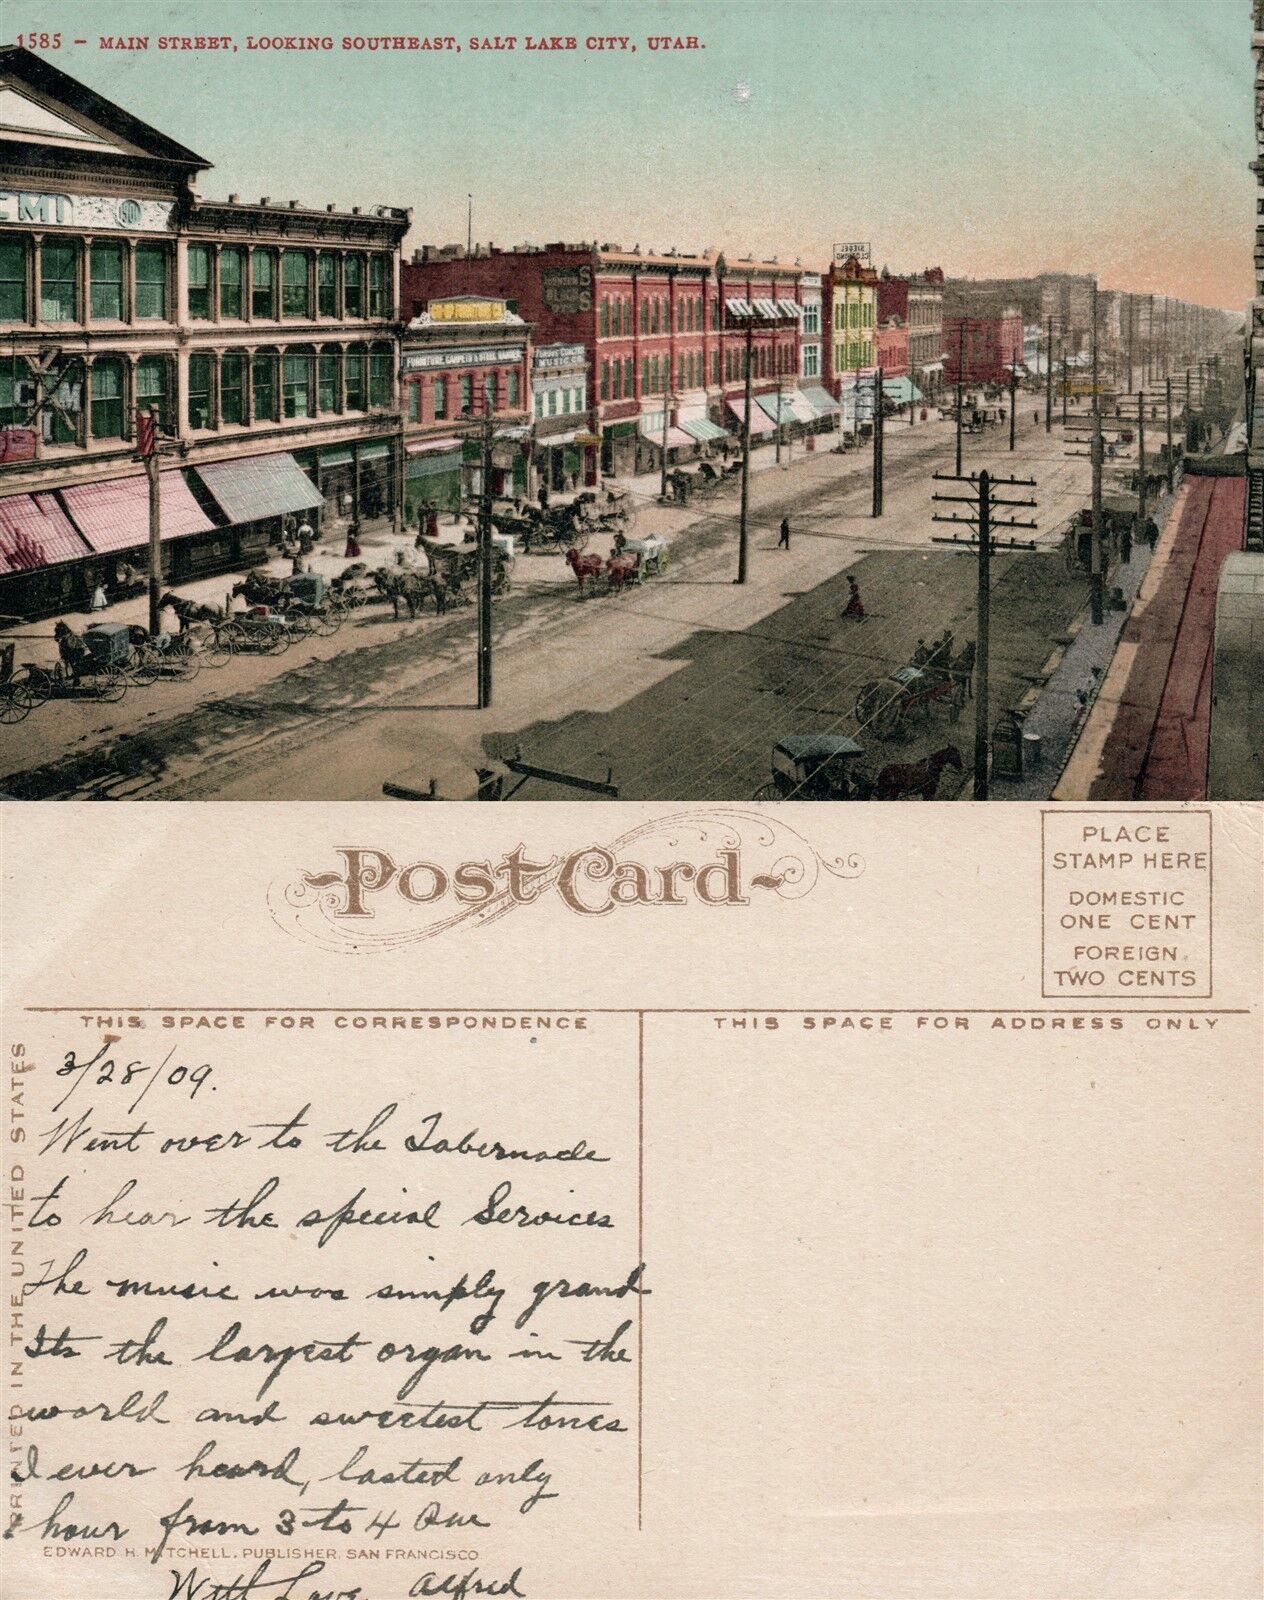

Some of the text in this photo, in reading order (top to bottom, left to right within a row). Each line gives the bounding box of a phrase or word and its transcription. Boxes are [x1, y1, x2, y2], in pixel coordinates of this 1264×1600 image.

[1083, 826, 1170, 842] PLACE
[333, 843, 750, 918] Post Card
[1053, 852, 1207, 869] STAMP HERE
[1069, 891, 1185, 906] DOMESTIC
[1060, 914, 1196, 929] ONE CENT
[1074, 946, 1178, 961] FOREIGN
[1053, 970, 1196, 986] TWO CENTS
[81, 1017, 588, 1029] THIS SPACE FOR CORRESPONDENCE
[714, 1017, 1222, 1030] THIS SPACE FOR ADDRESS ONLY
[10, 1042, 26, 1143] STATES
[38, 1107, 155, 1155] Went
[160, 1130, 252, 1154] over
[248, 1102, 312, 1149] to
[324, 1101, 398, 1153] the
[10, 1164, 25, 1278] UNITED
[28, 1176, 70, 1228] to
[80, 1179, 192, 1227] hear
[204, 1176, 280, 1229] the
[296, 1187, 441, 1248] special
[22, 1247, 652, 1335] The music was simply grand
[10, 1294, 24, 1346] THE
[10, 1361, 23, 1388] IN
[104, 1316, 173, 1365] the
[192, 1321, 372, 1401] largest
[377, 1342, 491, 1401] organ
[509, 1332, 562, 1361] in
[564, 1320, 632, 1363] the
[10, 1390, 628, 1432] world and sweetest tones
[11, 1444, 42, 1482] I
[47, 1461, 157, 1481] ever
[320, 1445, 463, 1487] lasted
[475, 1459, 559, 1514] only
[20, 1491, 130, 1541] hour
[151, 1497, 260, 1565] from
[276, 1508, 296, 1536] 3
[300, 1498, 367, 1531] to
[365, 1509, 400, 1540] 4
[43, 1546, 116, 1559] EDWARD
[125, 1546, 140, 1559] H.
[346, 1548, 380, 1560] SAN
